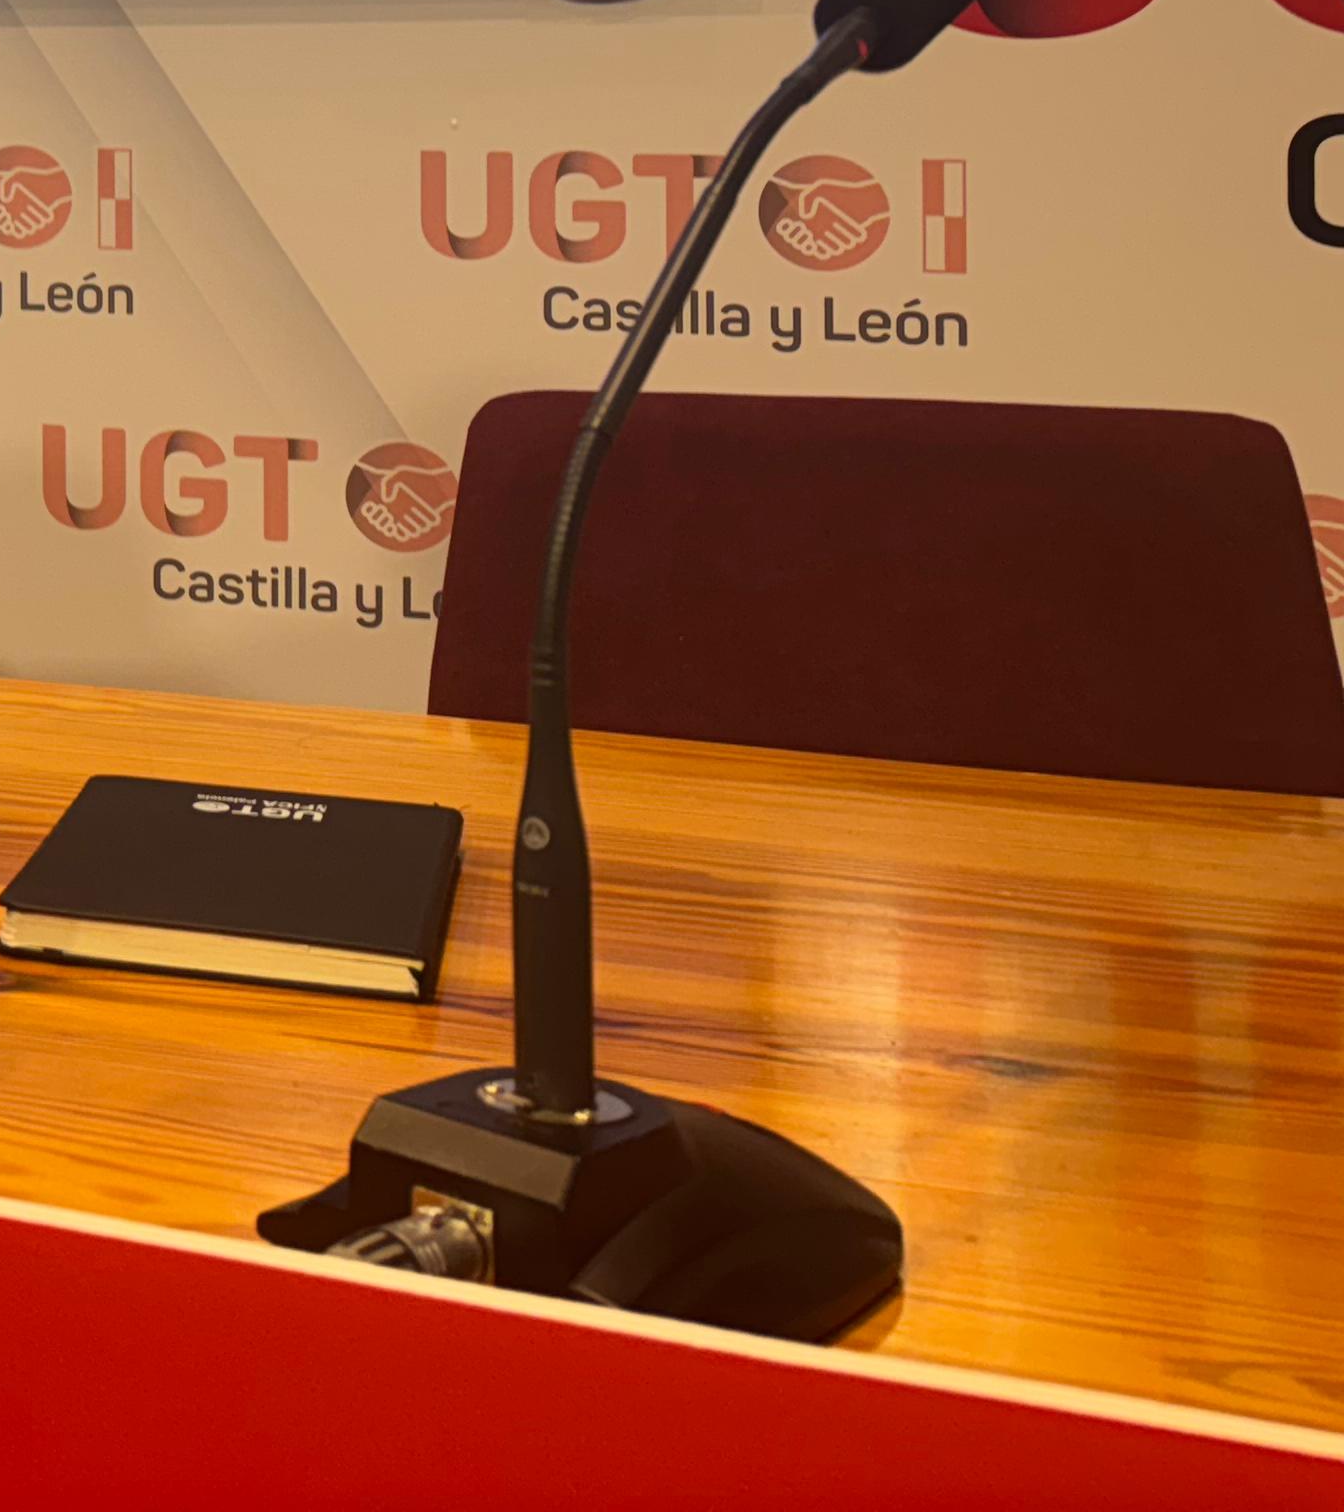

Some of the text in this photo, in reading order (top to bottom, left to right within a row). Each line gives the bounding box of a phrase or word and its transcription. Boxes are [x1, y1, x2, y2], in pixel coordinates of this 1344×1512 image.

[420, 149, 729, 265] UGT
[19, 271, 134, 315] León
[542, 285, 969, 353] Caslla y León
[41, 423, 320, 543] UGT
[152, 557, 338, 613] Castilla
[355, 583, 384, 629] y
[231, 804, 324, 823] UGT
